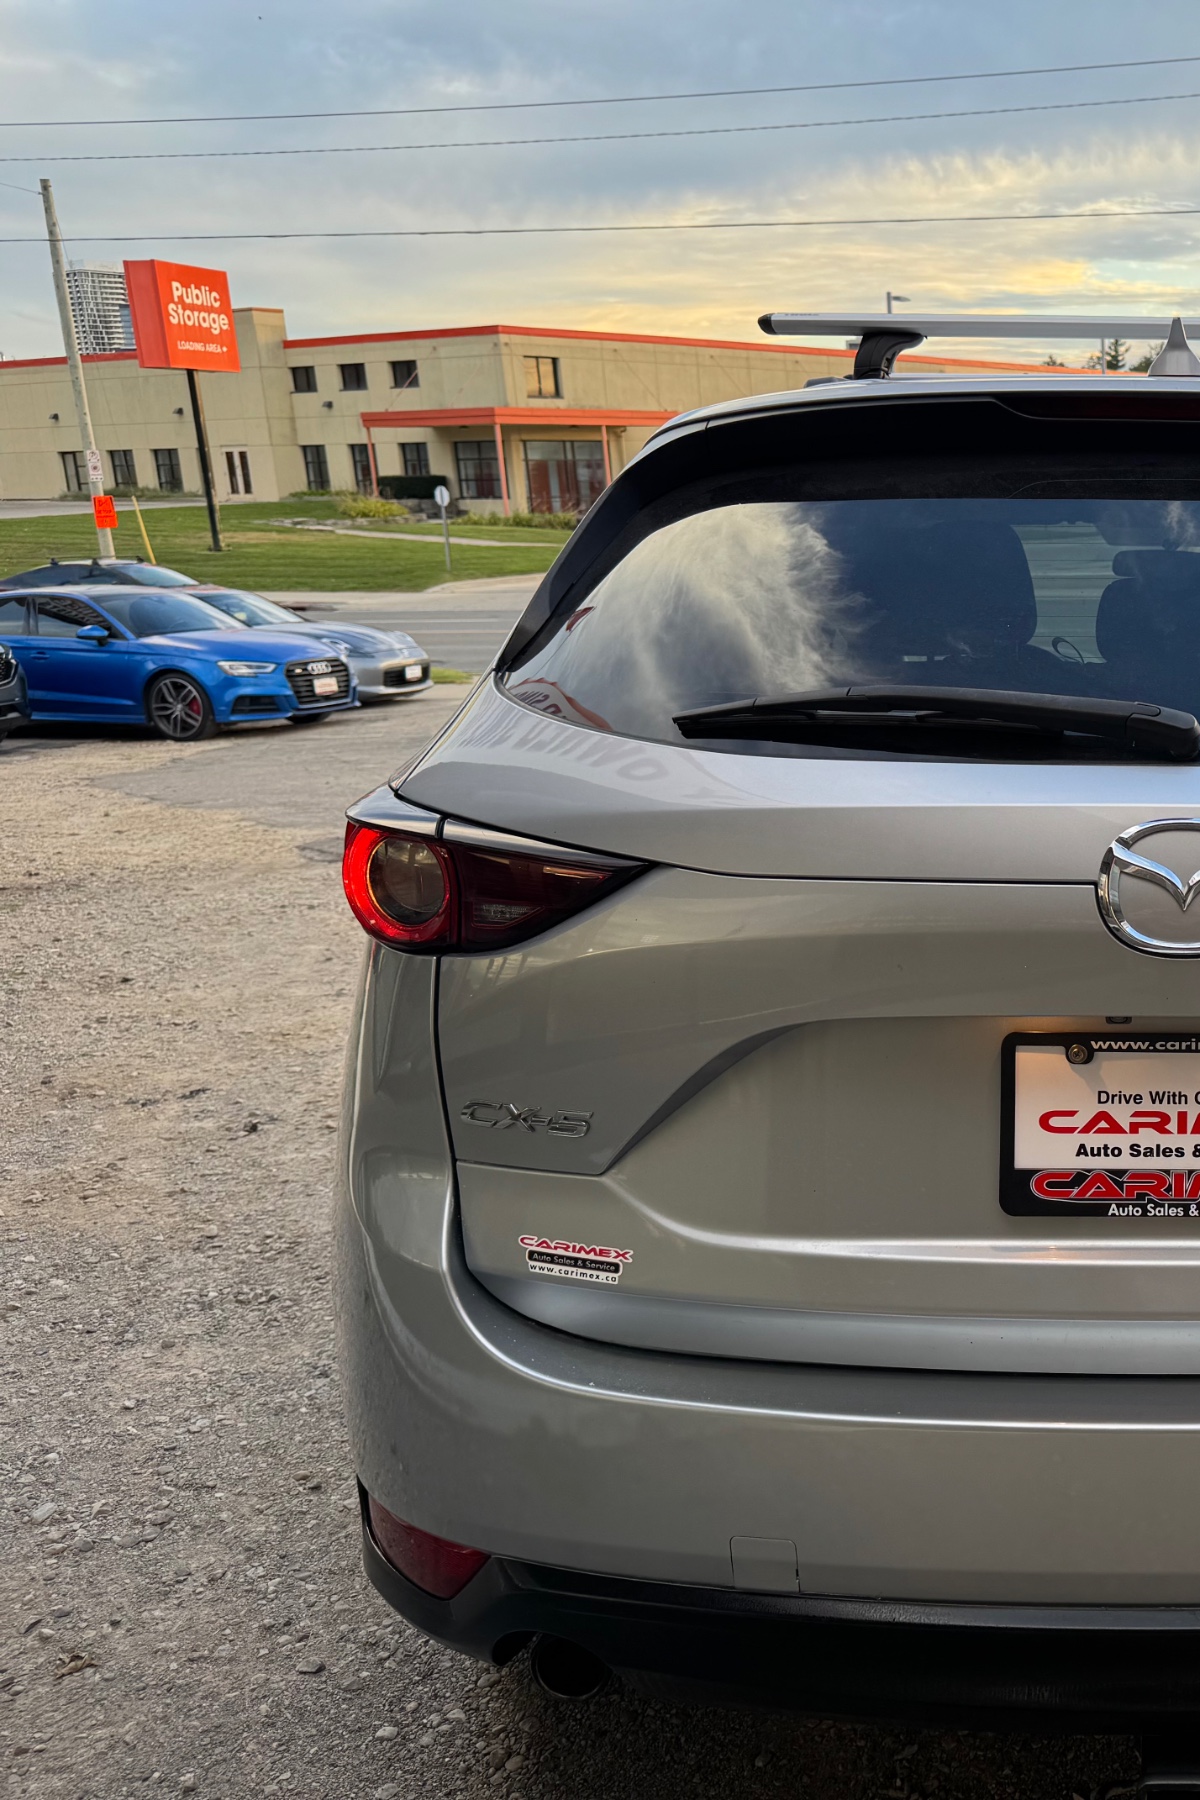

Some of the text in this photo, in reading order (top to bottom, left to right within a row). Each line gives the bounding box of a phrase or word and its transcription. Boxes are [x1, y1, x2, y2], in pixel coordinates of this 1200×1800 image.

[171, 281, 220, 308] Public
[167, 303, 229, 335] Storage
[177, 340, 222, 353] LOADING AREA
[1097, 1090, 1143, 1105] Drive
[1149, 1090, 1188, 1105] With
[460, 1100, 594, 1138] CX-5
[1075, 1143, 1122, 1158] Auto
[1129, 1143, 1185, 1158] Sales
[1108, 1203, 1142, 1217] Auto
[1146, 1203, 1185, 1217] Sales
[1188, 1203, 1199, 1217] &
[519, 1236, 632, 1261] CARIMEX
[532, 1253, 551, 1262] Auto
[553, 1255, 575, 1265] Sales
[586, 1261, 615, 1272] Service
[529, 1263, 617, 1282] www.carimex.ca
